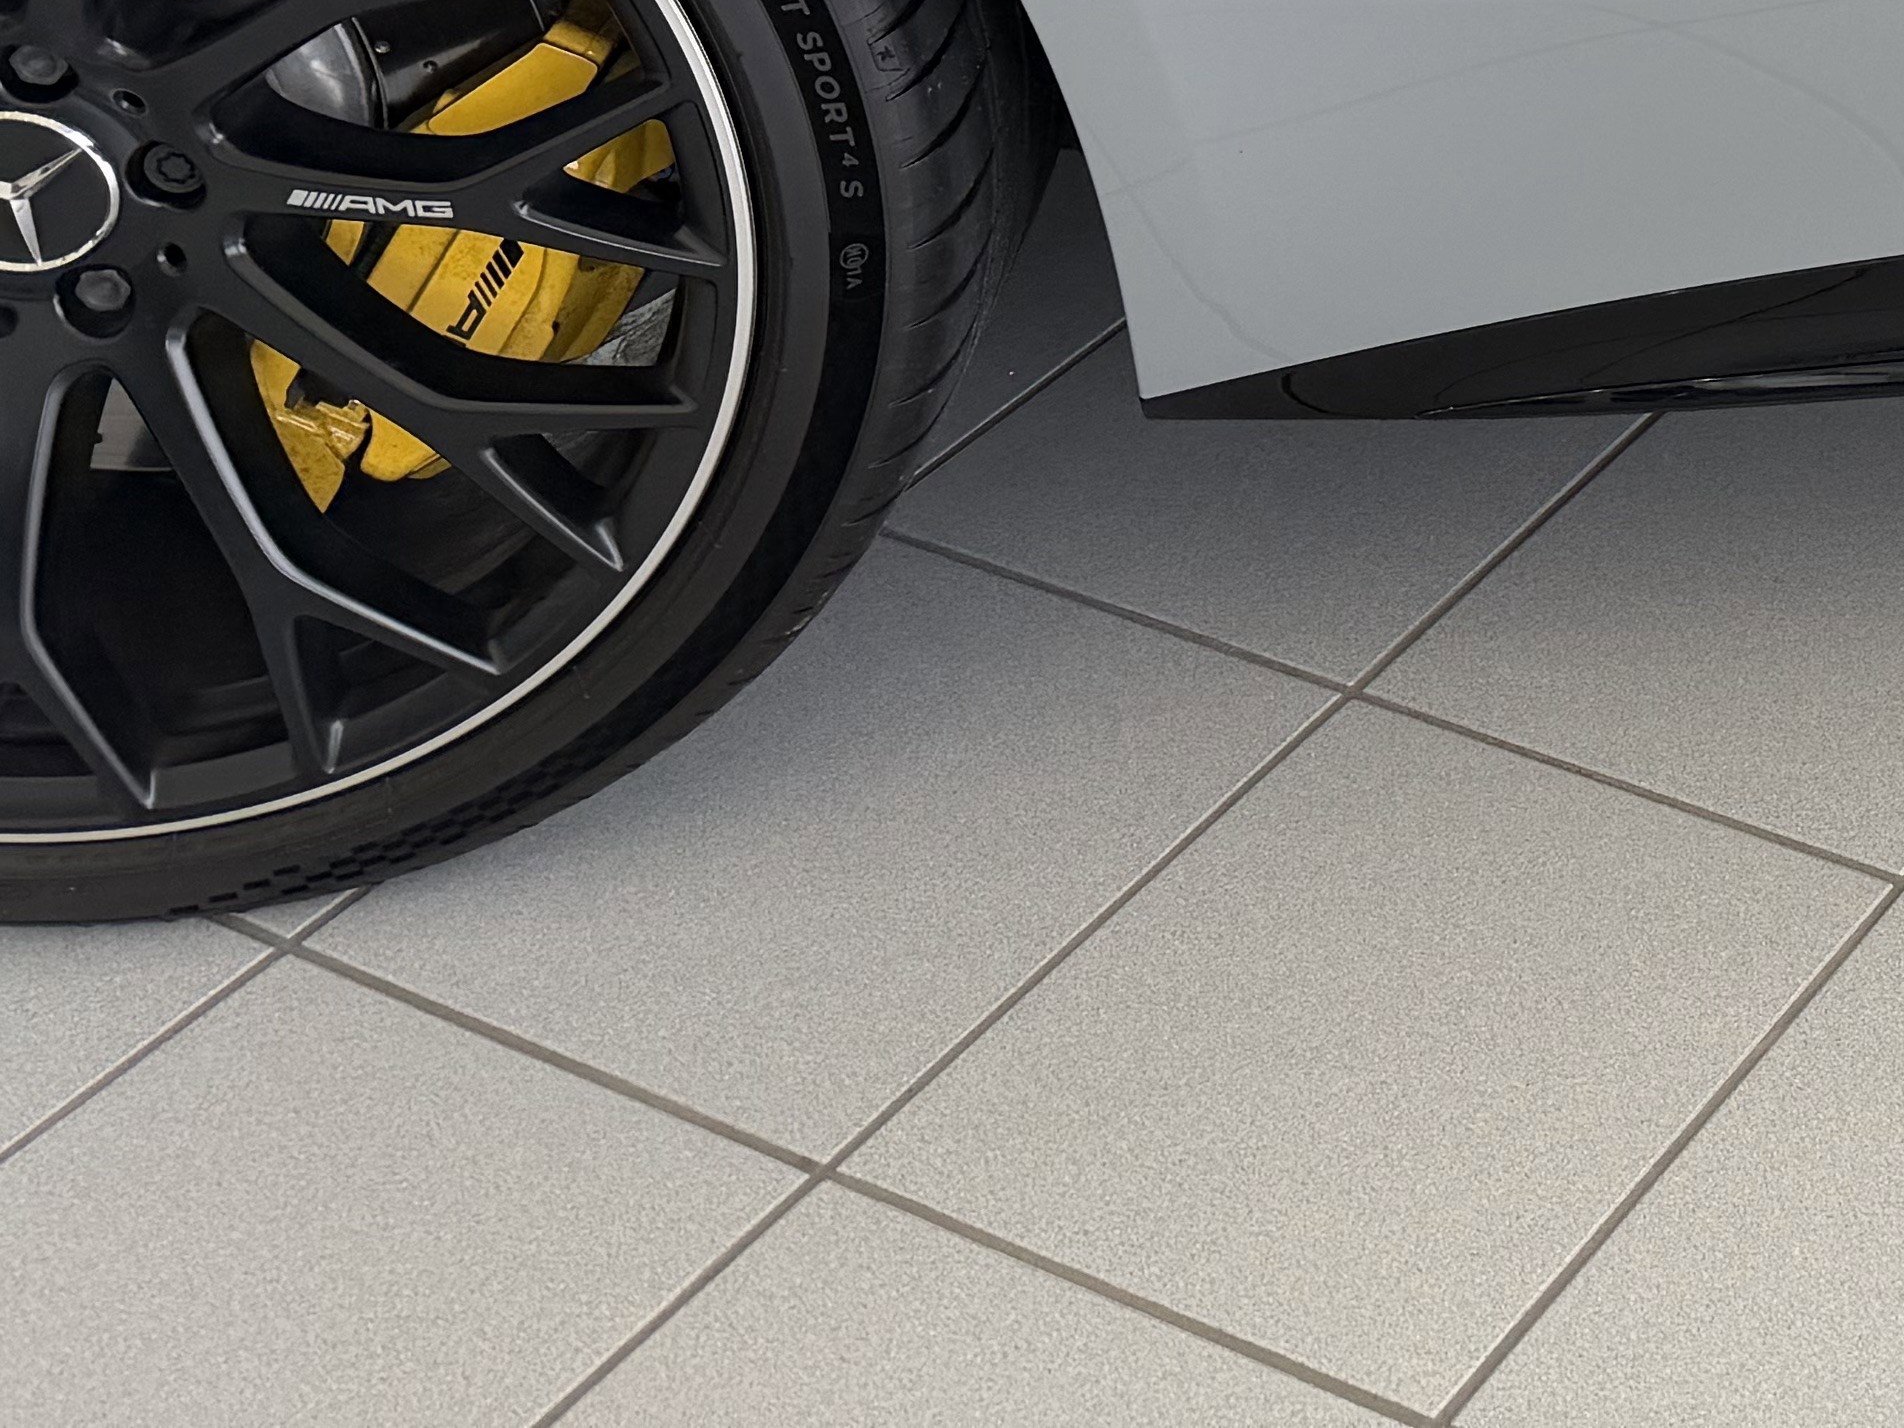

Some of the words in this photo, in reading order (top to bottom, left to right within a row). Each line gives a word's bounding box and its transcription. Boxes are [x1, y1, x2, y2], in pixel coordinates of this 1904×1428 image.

[796, 31, 856, 147] SPORT
[843, 152, 860, 168] 4
[840, 180, 864, 198] S
[338, 194, 454, 219] AMG
